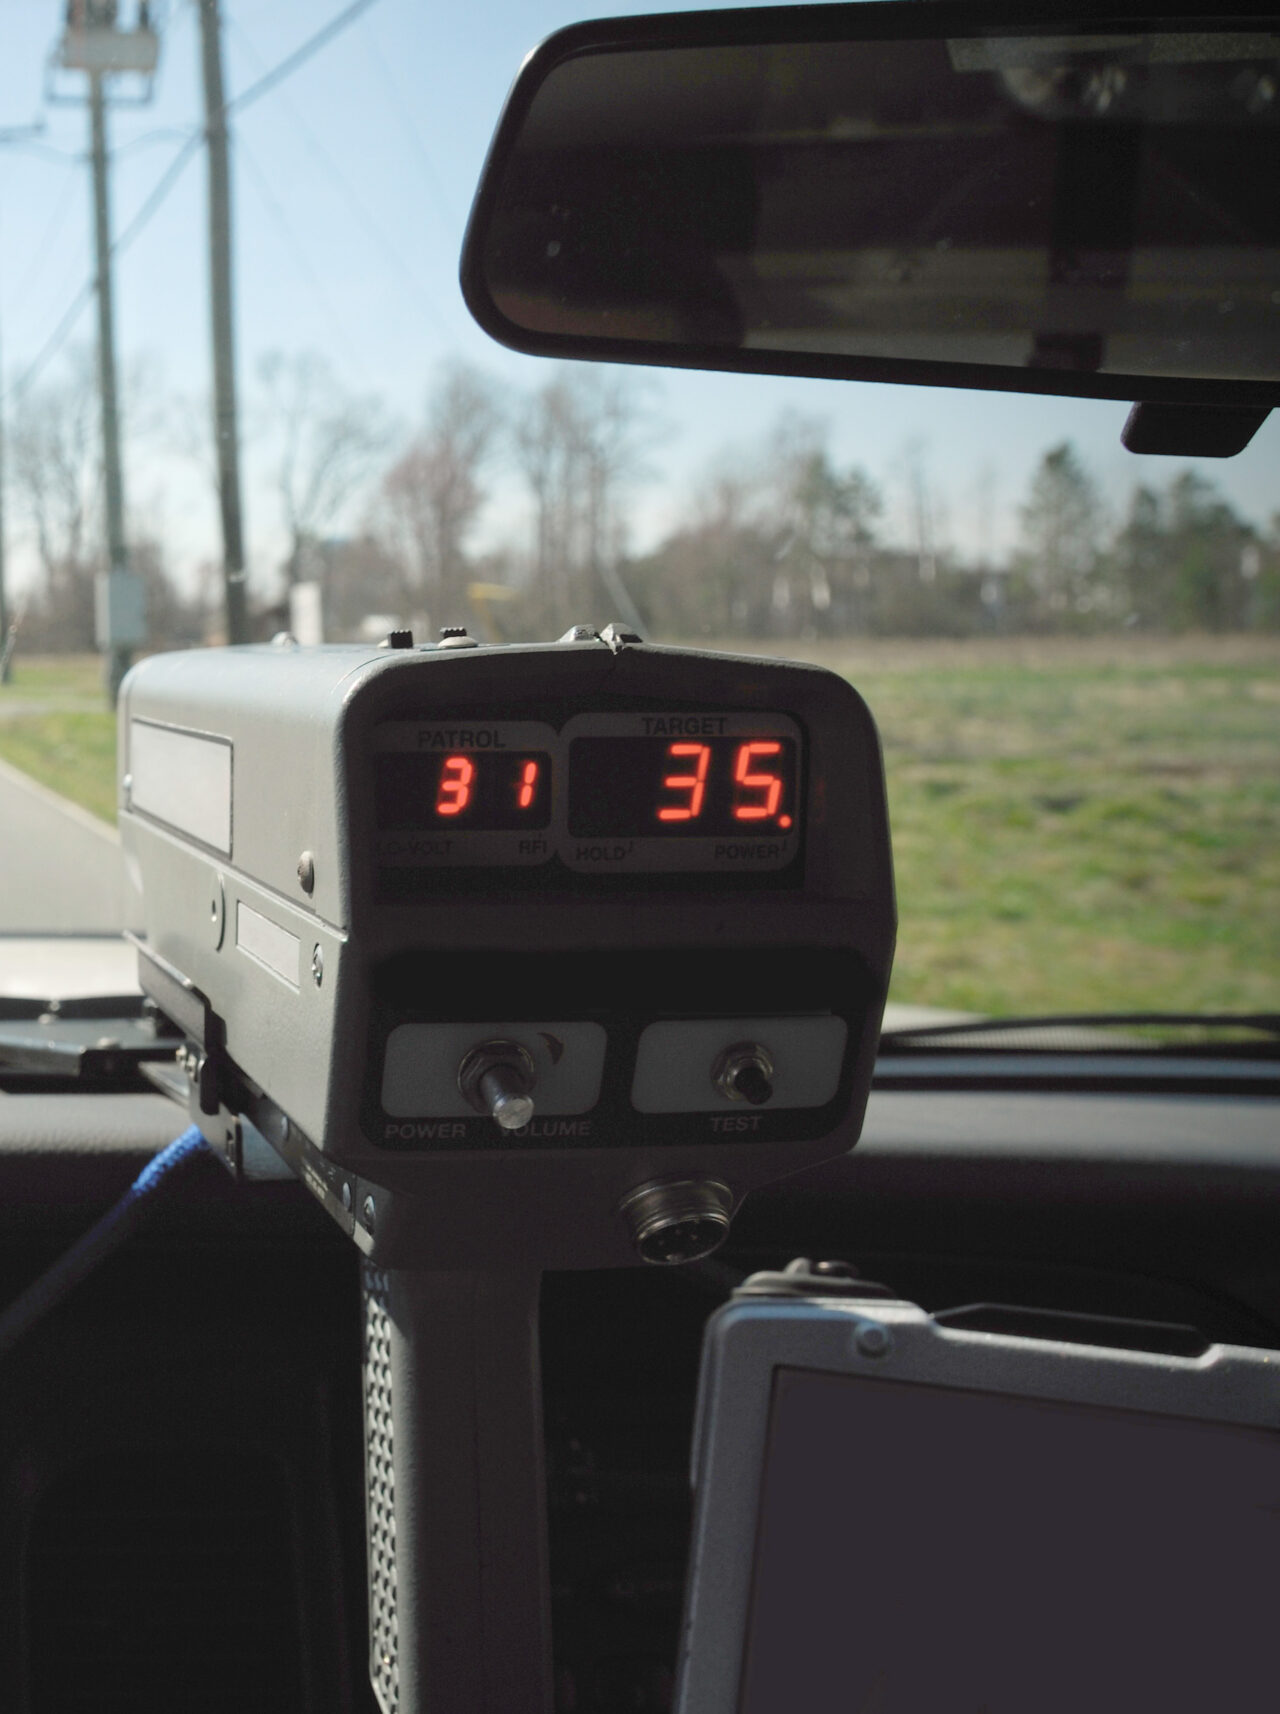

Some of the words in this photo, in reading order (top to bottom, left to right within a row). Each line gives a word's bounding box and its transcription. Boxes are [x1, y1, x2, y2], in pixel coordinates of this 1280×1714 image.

[641, 716, 728, 736] TARGET
[418, 729, 506, 748] PATROL
[518, 840, 548, 855] RFI
[575, 846, 625, 862] HOLD
[713, 844, 779, 861] POWER
[384, 1122, 466, 1140] POWER
[710, 1115, 763, 1133] TEST
